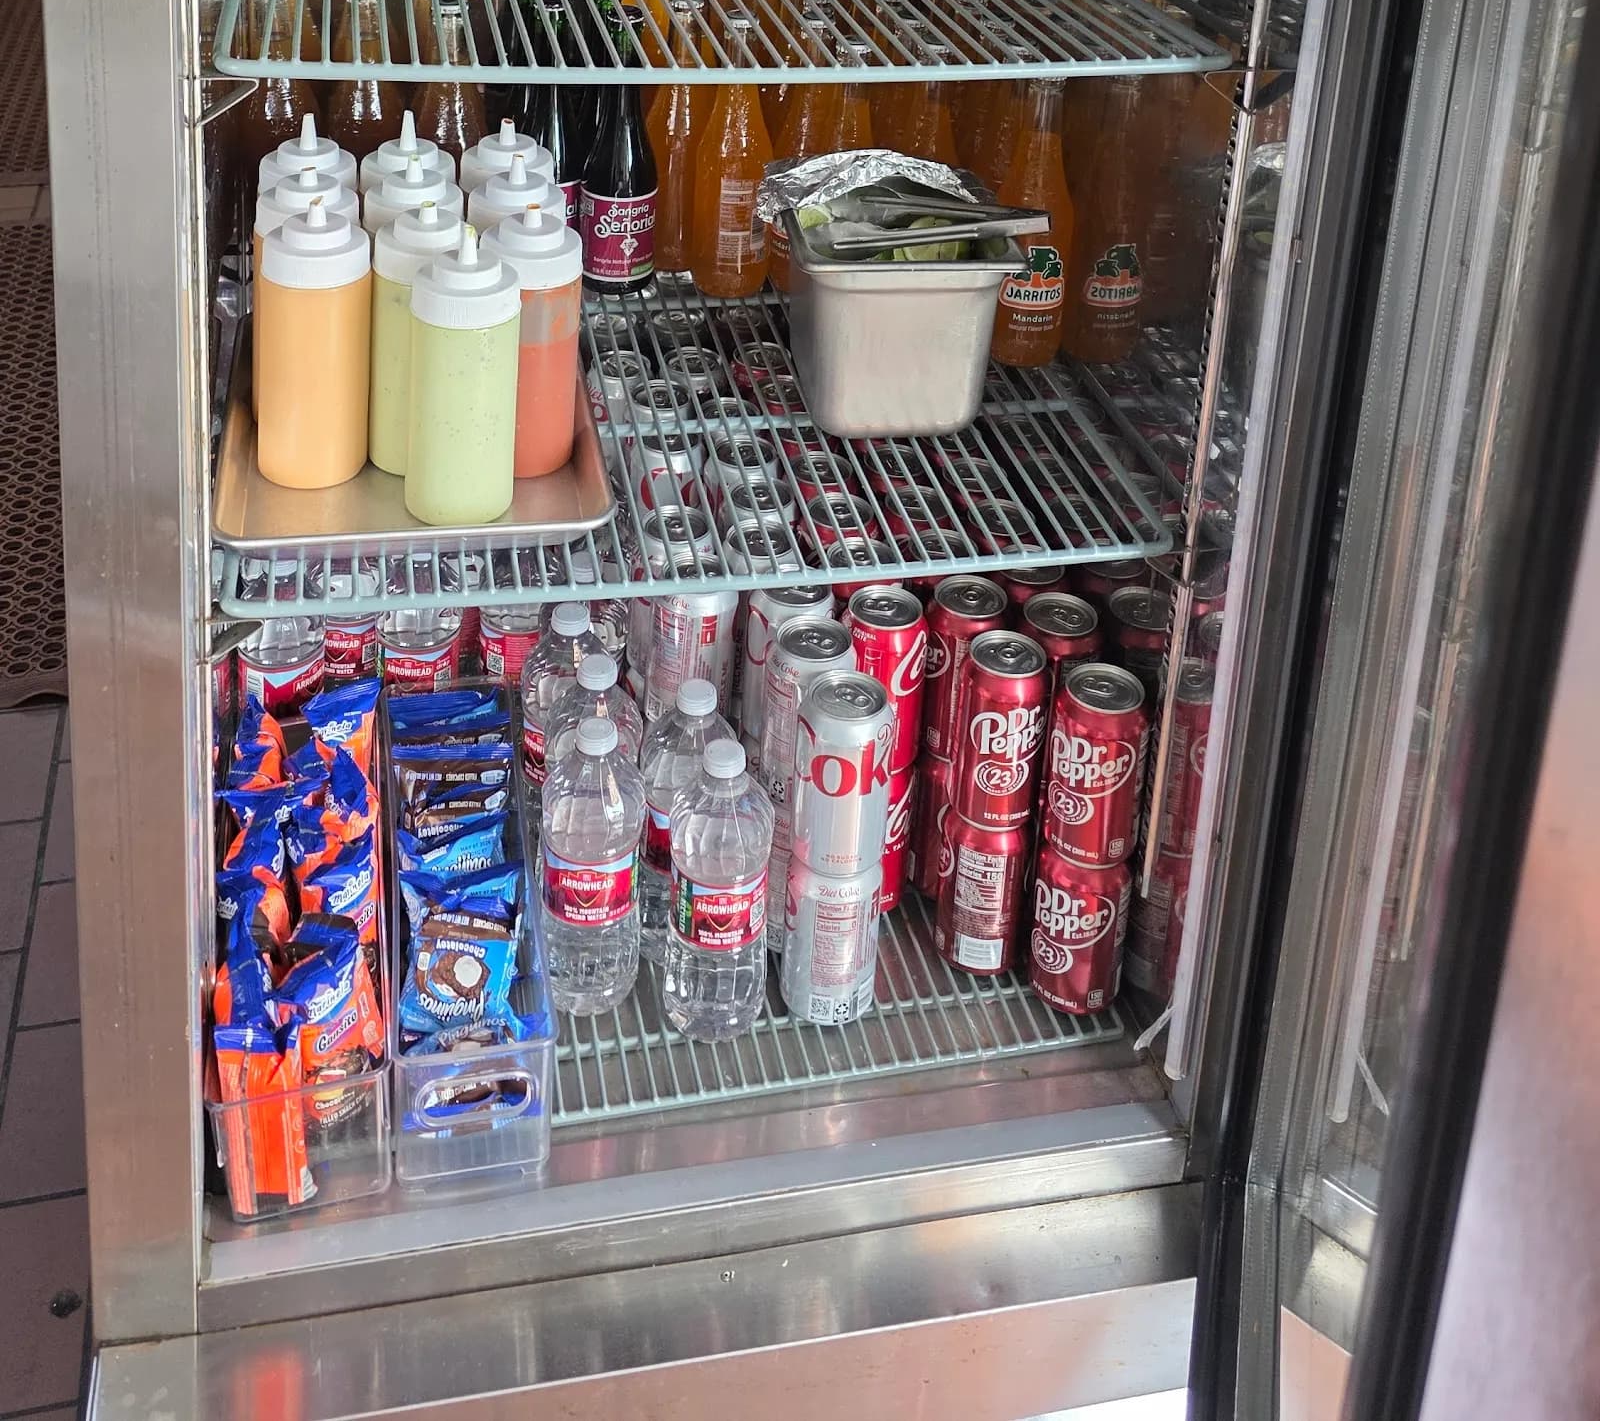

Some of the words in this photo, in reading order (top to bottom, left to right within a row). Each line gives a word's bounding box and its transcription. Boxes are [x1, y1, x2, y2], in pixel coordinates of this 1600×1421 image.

[1006, 286, 1061, 302] JARRITOS
[1012, 313, 1053, 323] Mandarin
[387, 663, 432, 677] ARROWHEAD
[780, 663, 800, 676] Coke
[1008, 705, 1041, 735] Dr
[971, 711, 1046, 760] Peppe
[1051, 729, 1130, 787] Pepper
[1070, 736, 1108, 764] Dr
[989, 769, 1012, 788] 23
[1056, 792, 1075, 815] 23
[1064, 842, 1072, 851] OZ
[328, 870, 372, 907] Marinela
[562, 878, 614, 891] ARROWHEAD
[817, 885, 837, 897] Diet
[580, 905, 609, 915] MOUNTAIN
[696, 901, 749, 915] ARROWHEAD
[1035, 880, 1109, 939] Pepper
[1051, 887, 1087, 916] Dr
[357, 903, 374, 929] sito
[436, 938, 486, 958] Chocolatey
[1038, 940, 1055, 963] 23
[419, 990, 485, 1022] Pingüinos
[318, 1011, 358, 1052] Gansito
